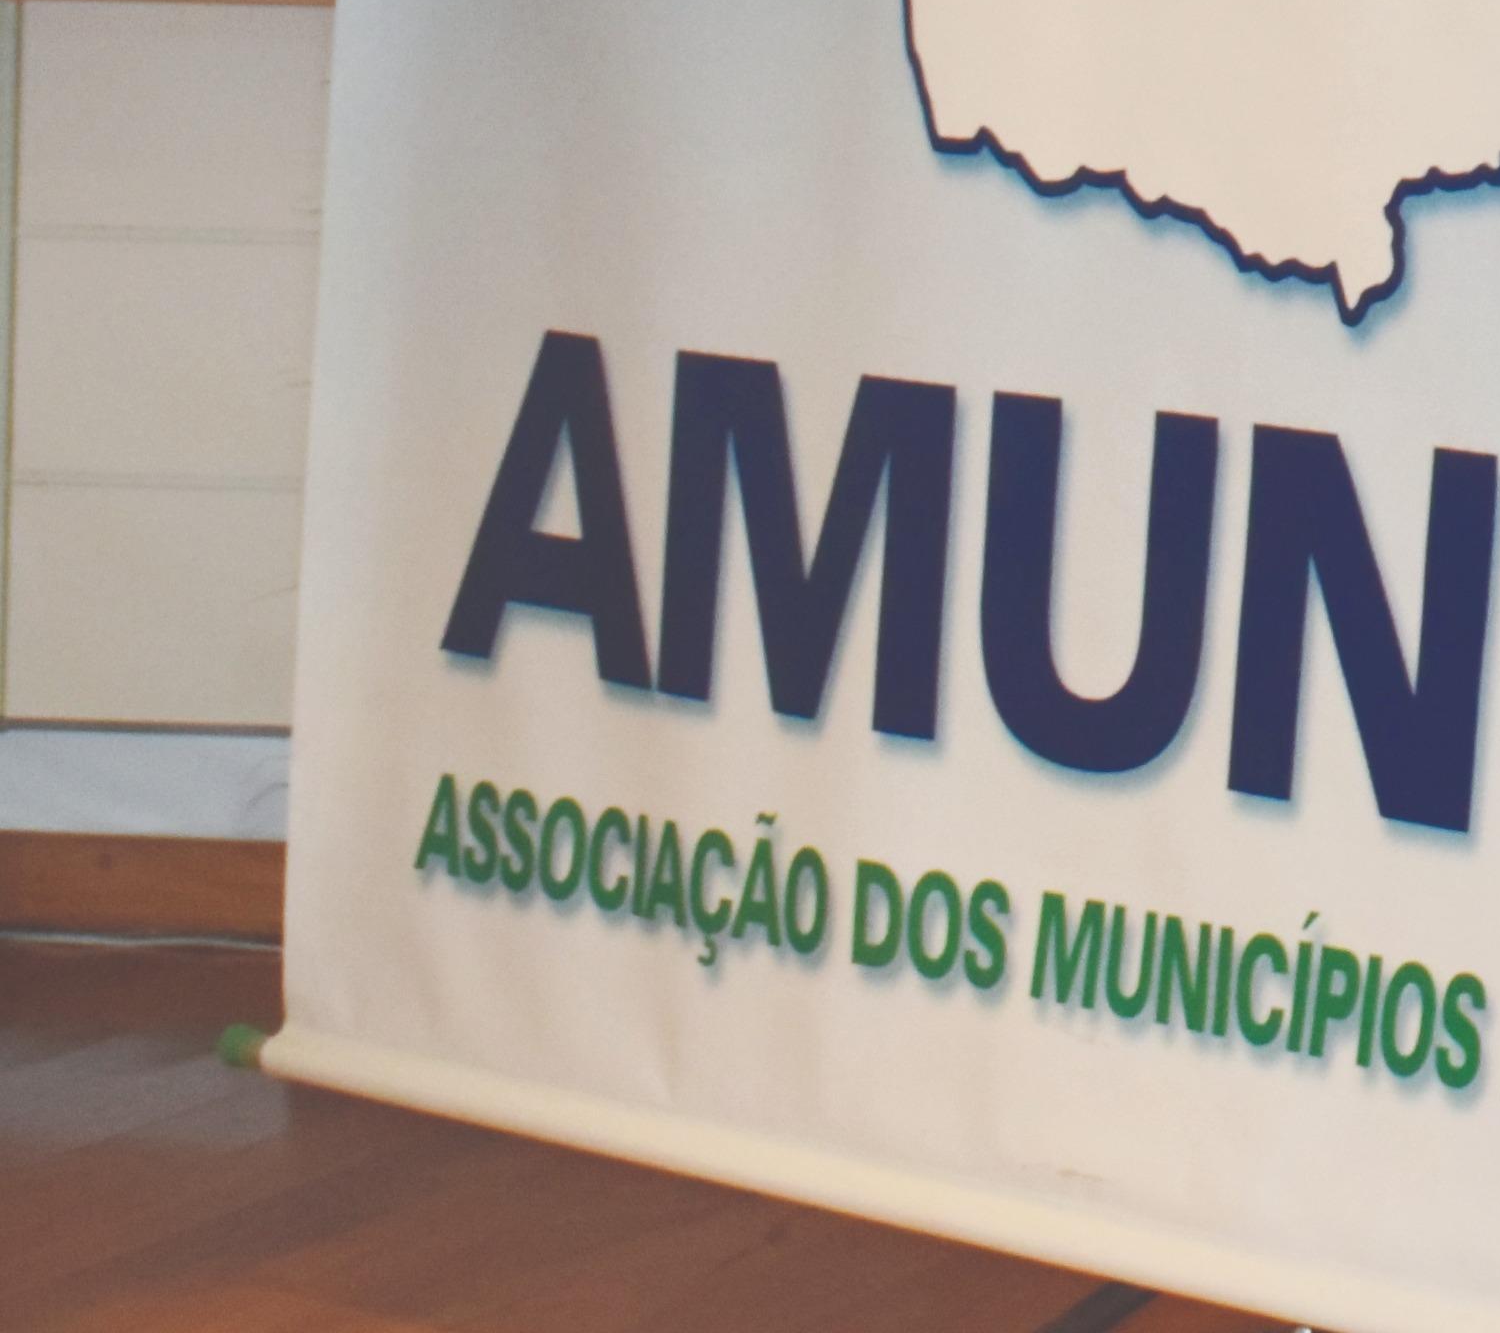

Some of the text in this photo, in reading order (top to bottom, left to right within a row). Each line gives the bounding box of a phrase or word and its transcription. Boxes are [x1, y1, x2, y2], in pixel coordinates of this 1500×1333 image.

[414, 772, 829, 966] ASSOCIAÇÃO
[850, 858, 1012, 990] DOS
[1029, 890, 1487, 1090] MUNICÍPIOS
